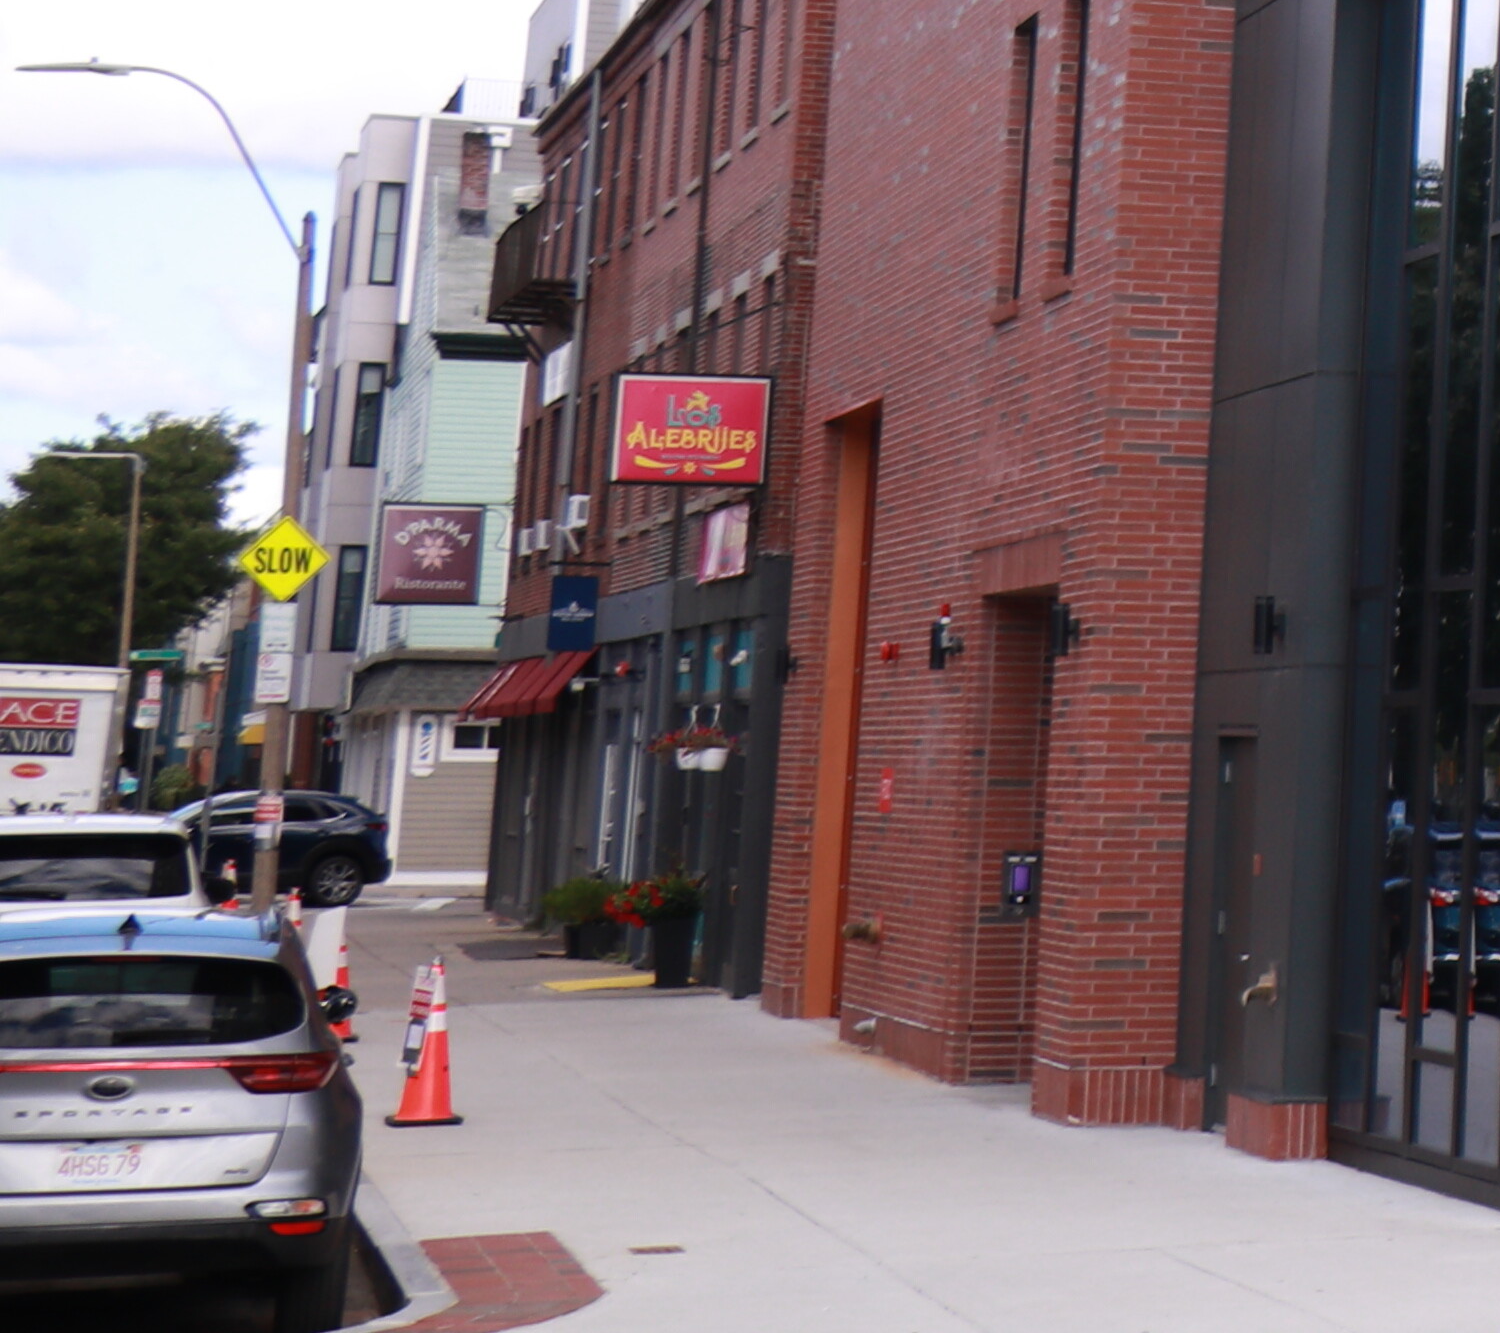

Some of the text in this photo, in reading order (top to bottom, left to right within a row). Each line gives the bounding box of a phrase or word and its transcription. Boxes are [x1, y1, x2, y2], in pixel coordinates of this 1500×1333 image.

[254, 546, 313, 574] SLOW
[394, 576, 467, 591] Ristorante
[115, 1153, 141, 1175] 79
